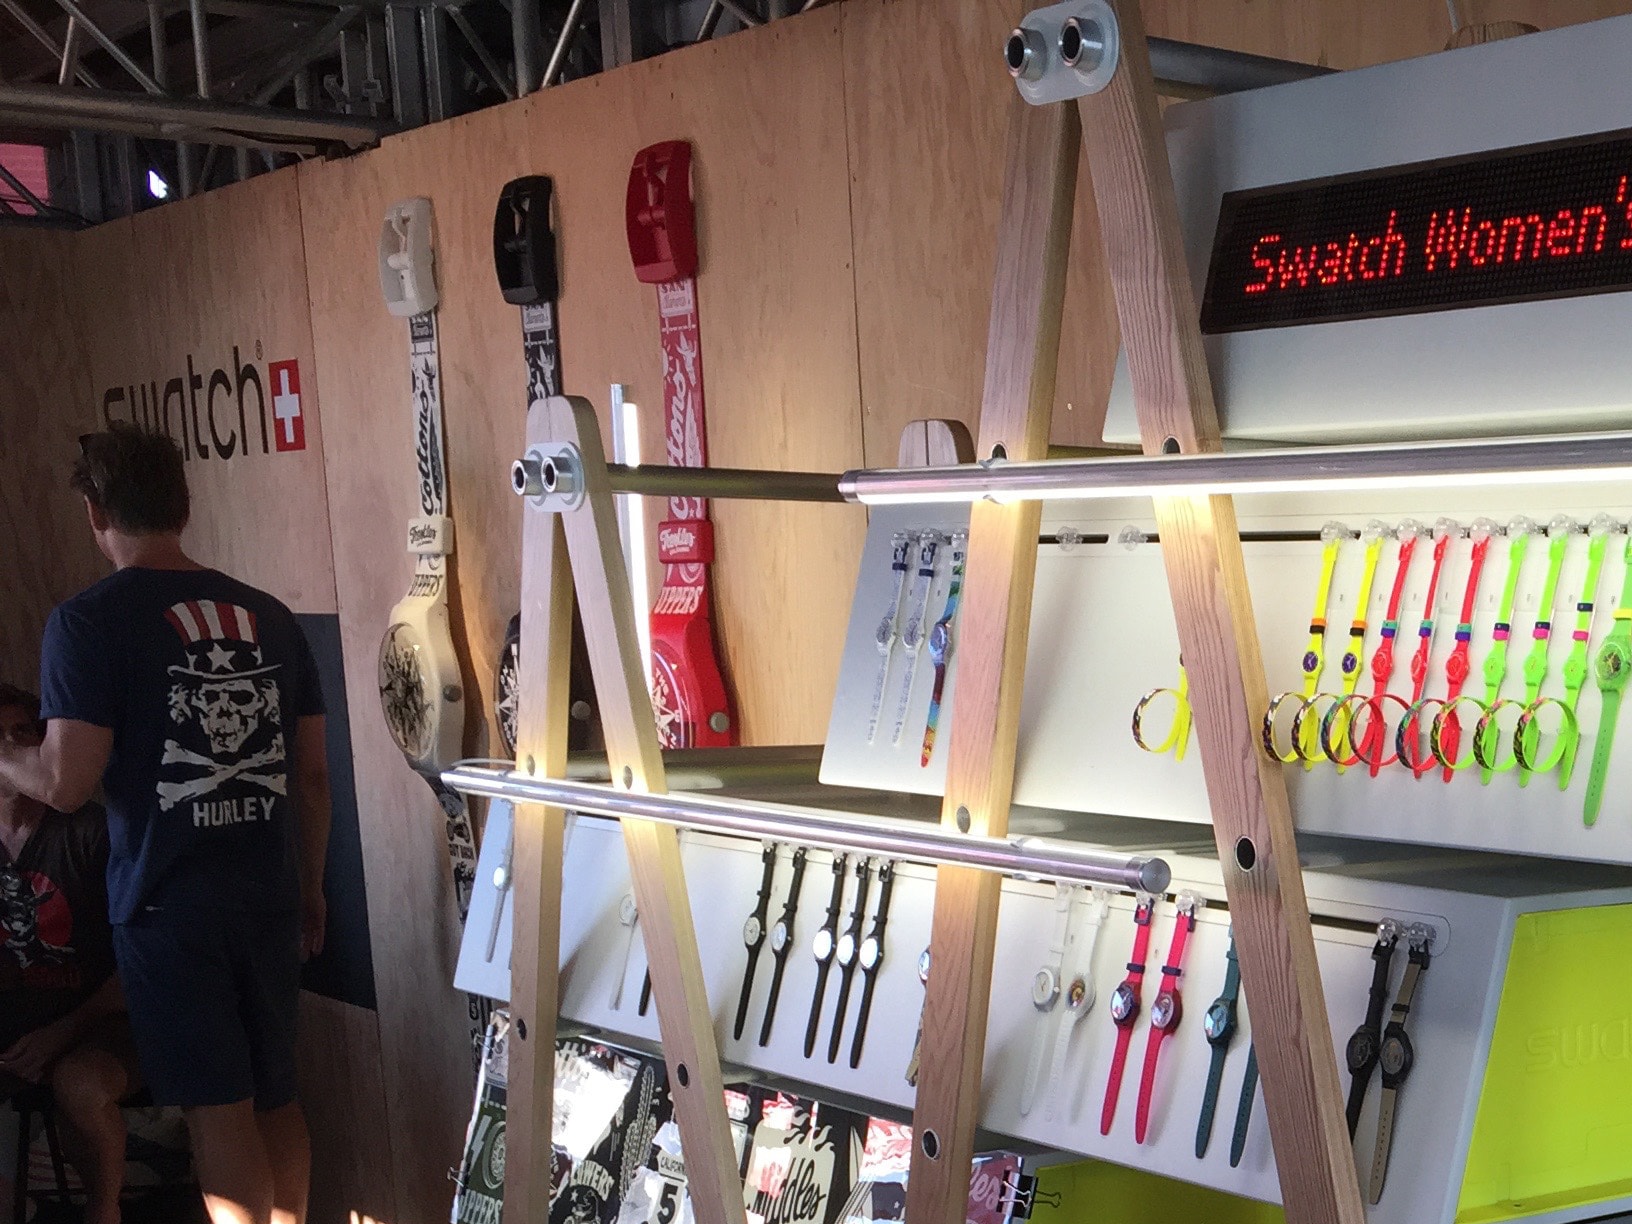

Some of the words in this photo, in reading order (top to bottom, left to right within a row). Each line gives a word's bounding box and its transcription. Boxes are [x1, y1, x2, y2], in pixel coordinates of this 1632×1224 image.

[1245, 210, 1405, 293] Swatch
[654, 585, 703, 615] UPPERS
[192, 796, 276, 827] HURLEY
